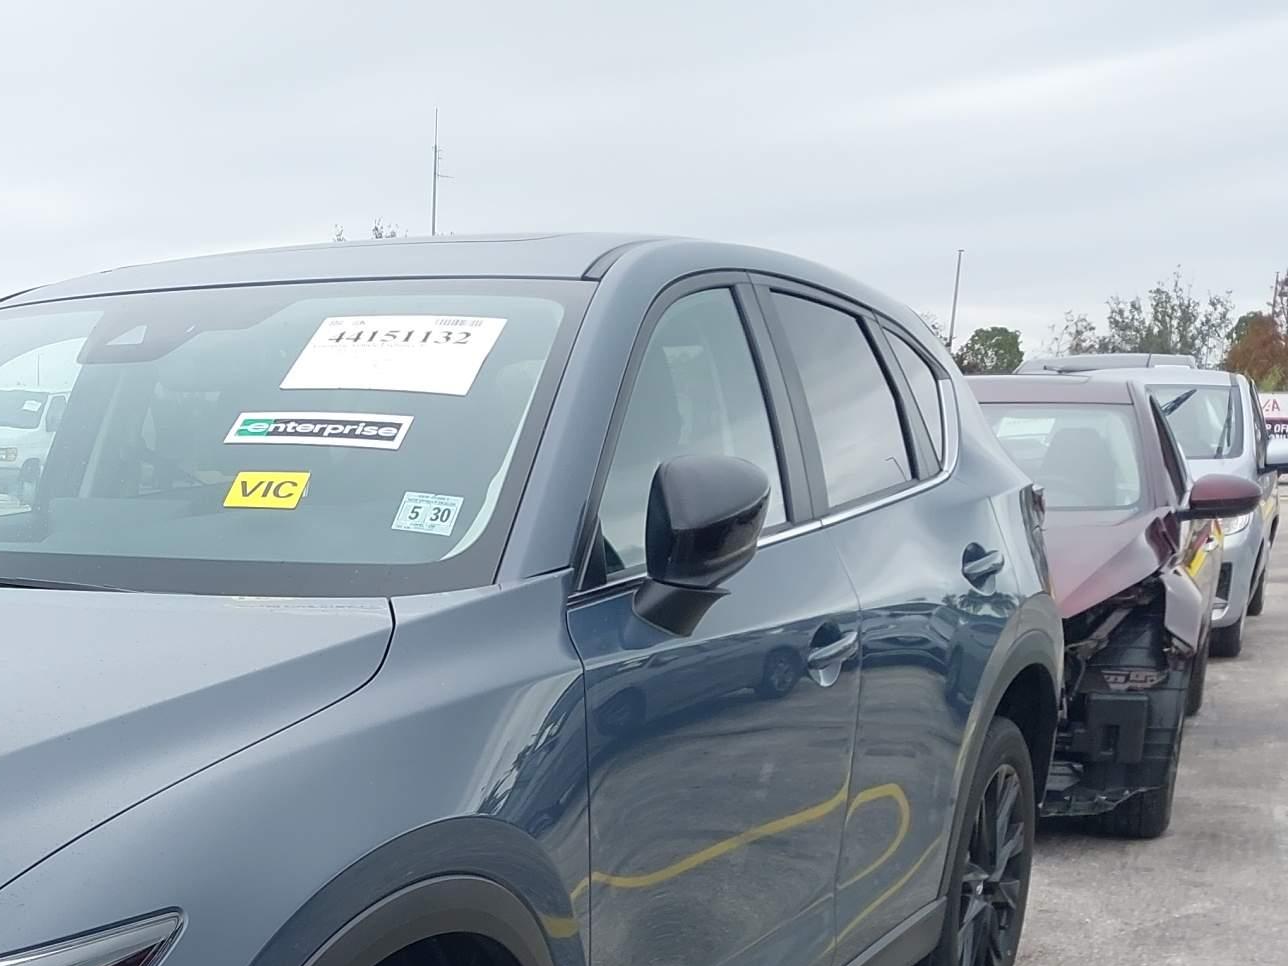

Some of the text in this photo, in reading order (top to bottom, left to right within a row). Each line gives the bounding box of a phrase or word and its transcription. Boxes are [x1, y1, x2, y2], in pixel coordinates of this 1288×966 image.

[328, 329, 472, 345] 44151132
[245, 420, 399, 438] enterprise
[240, 480, 298, 499] VIC
[408, 505, 452, 523] 5 30
